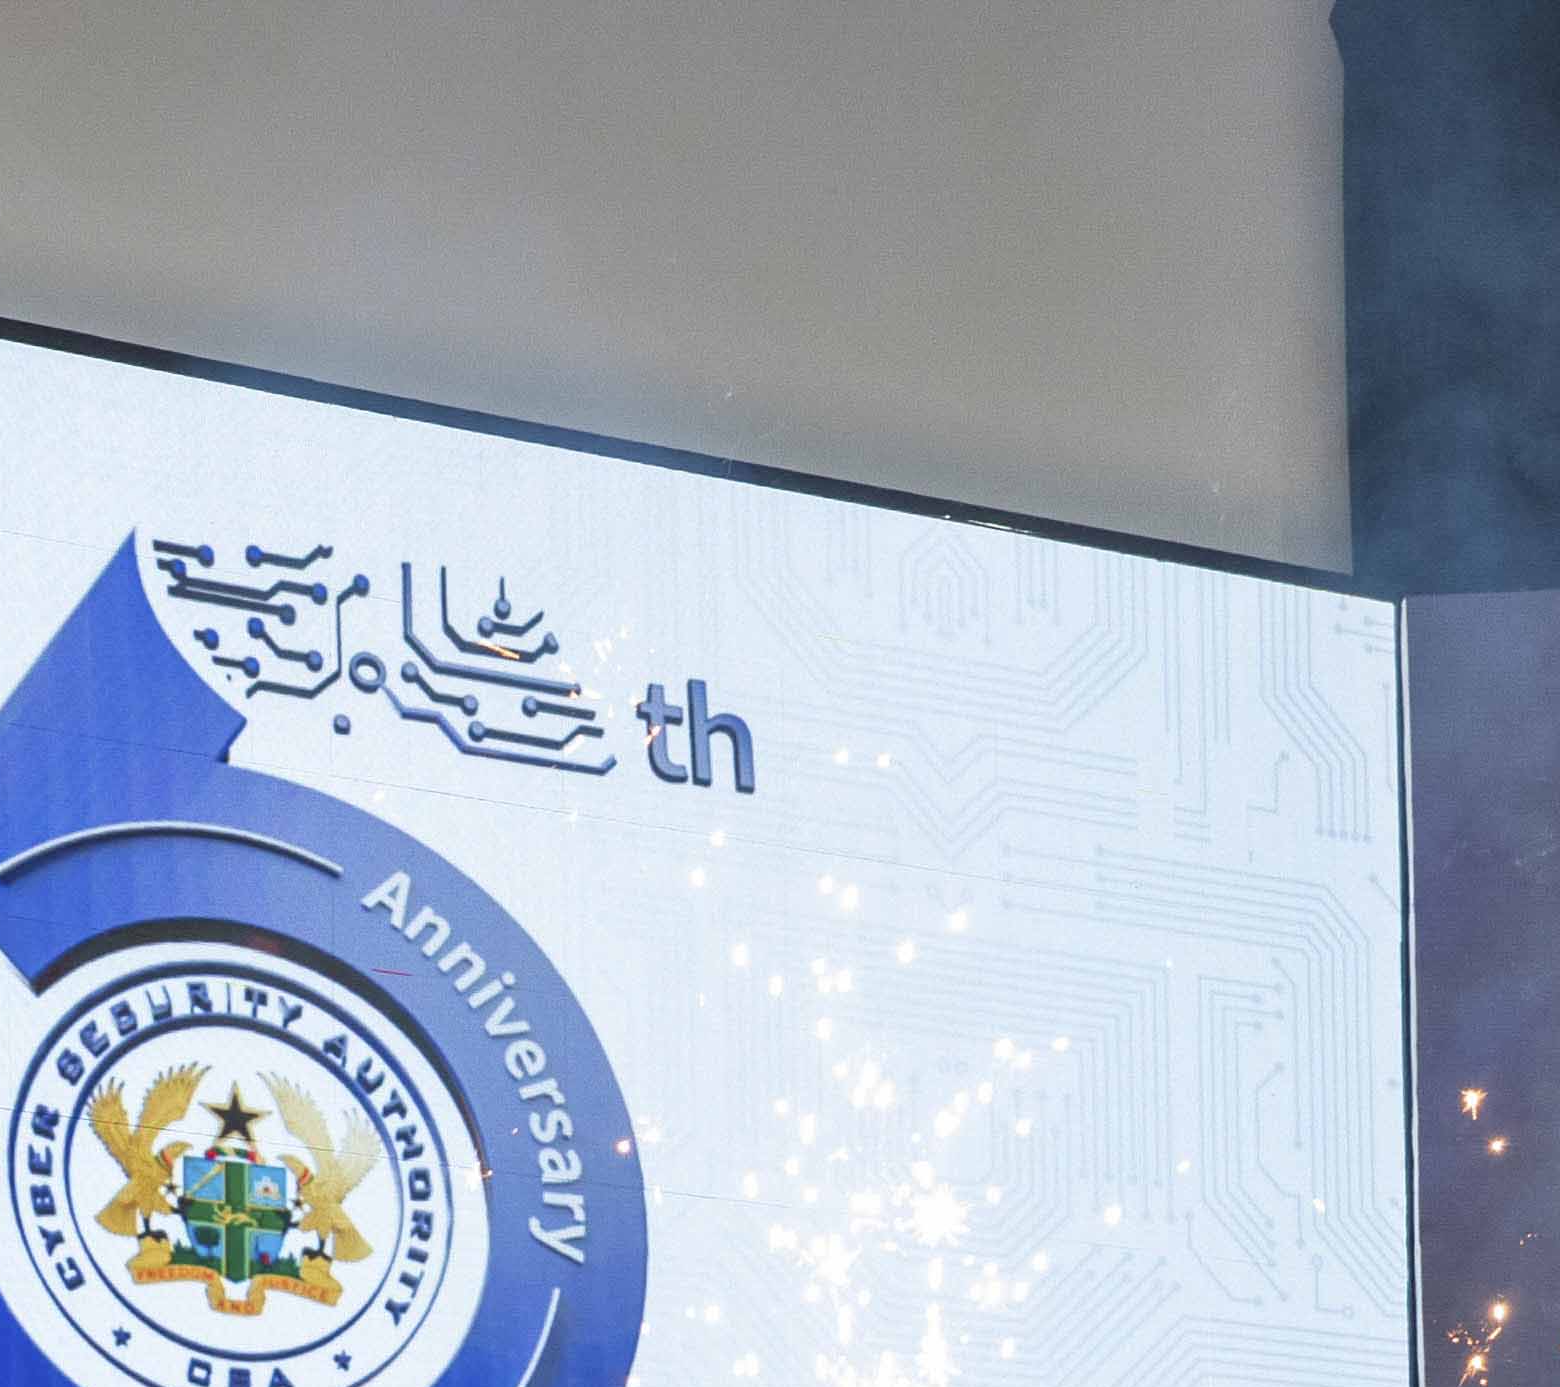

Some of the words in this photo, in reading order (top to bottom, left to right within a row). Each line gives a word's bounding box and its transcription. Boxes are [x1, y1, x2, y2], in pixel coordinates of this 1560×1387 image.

[27, 1103, 87, 1292] CYBER
[322, 1032, 434, 1328] AUTHORITY
[360, 869, 586, 1264] Anniversary
